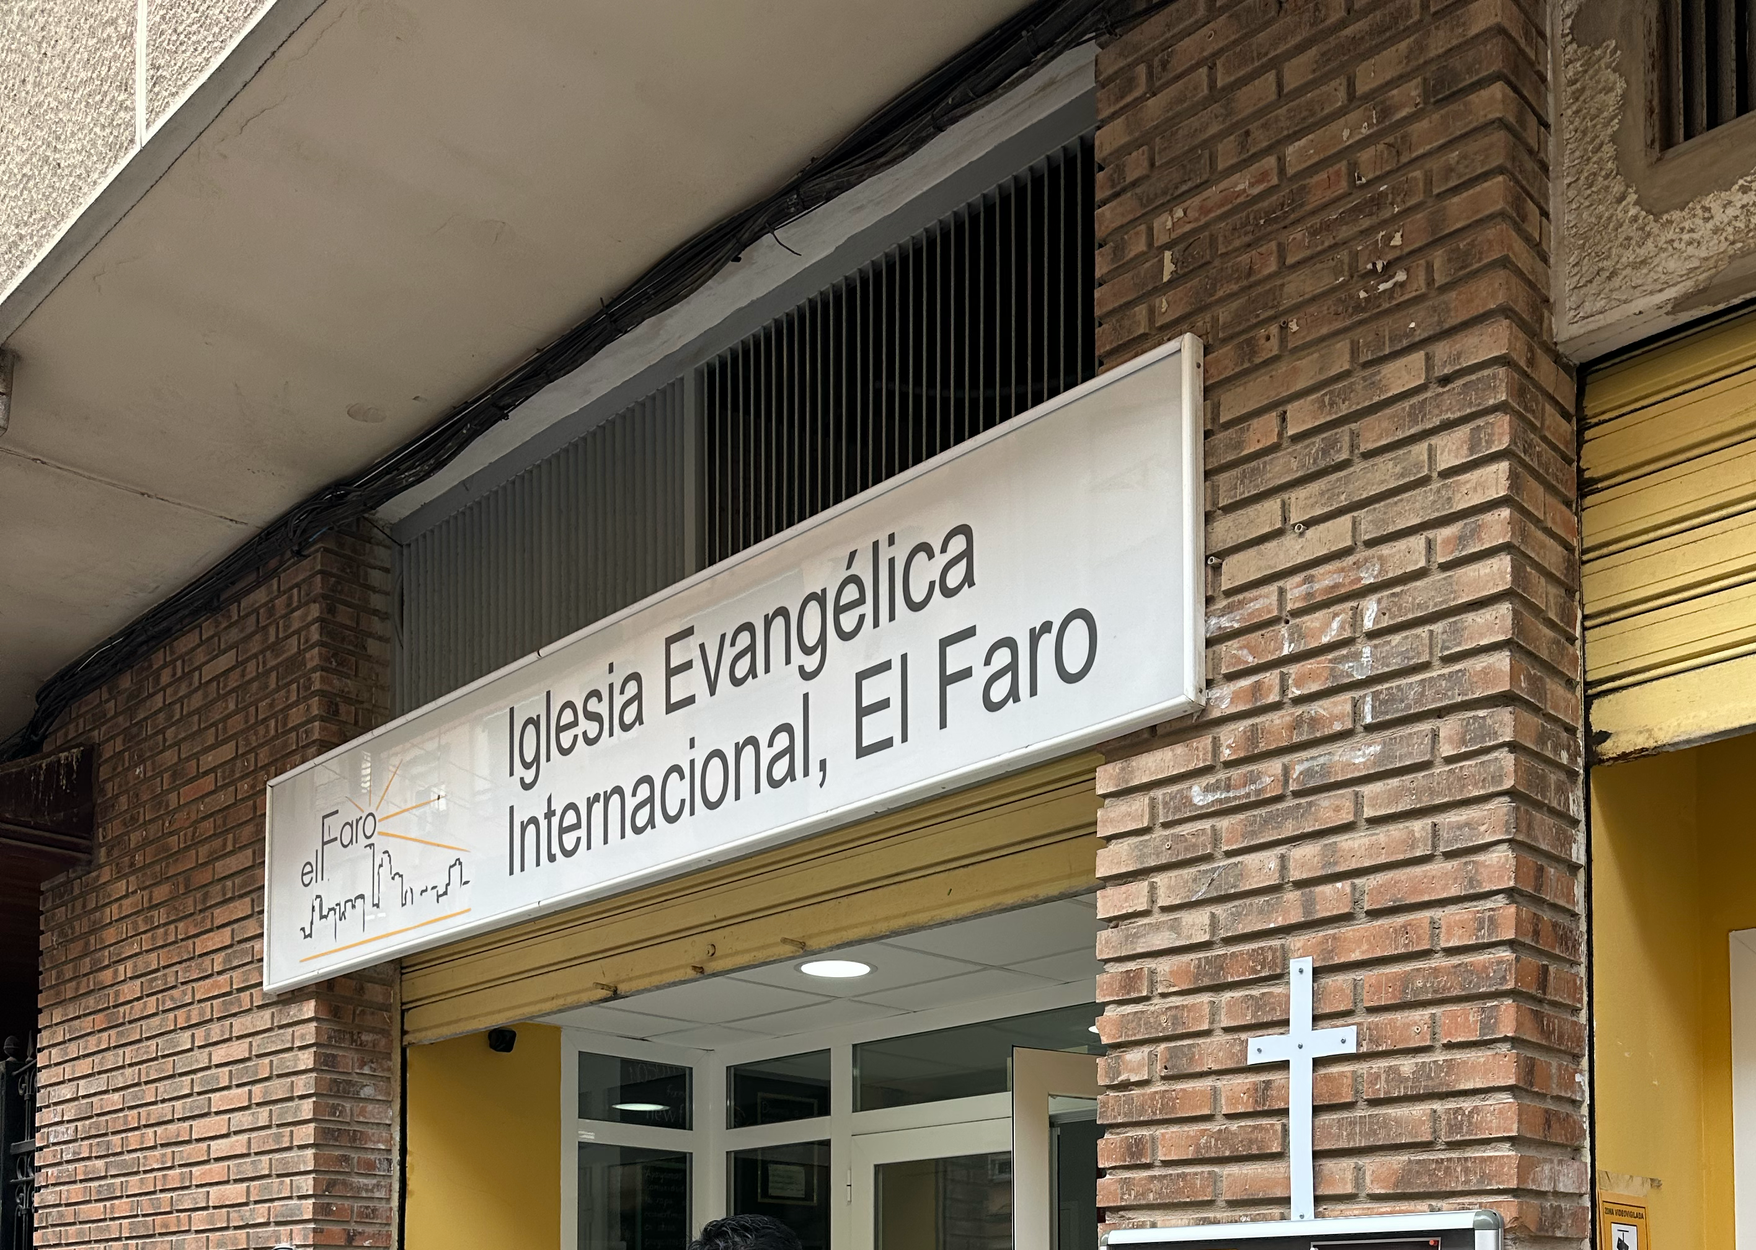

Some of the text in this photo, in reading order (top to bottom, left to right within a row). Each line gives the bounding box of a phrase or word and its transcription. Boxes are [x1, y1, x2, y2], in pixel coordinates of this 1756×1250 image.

[508, 523, 977, 791] Iglesia Evangélica
[508, 607, 1098, 877] Internacional, El Faro
[300, 809, 377, 888] el Faro
